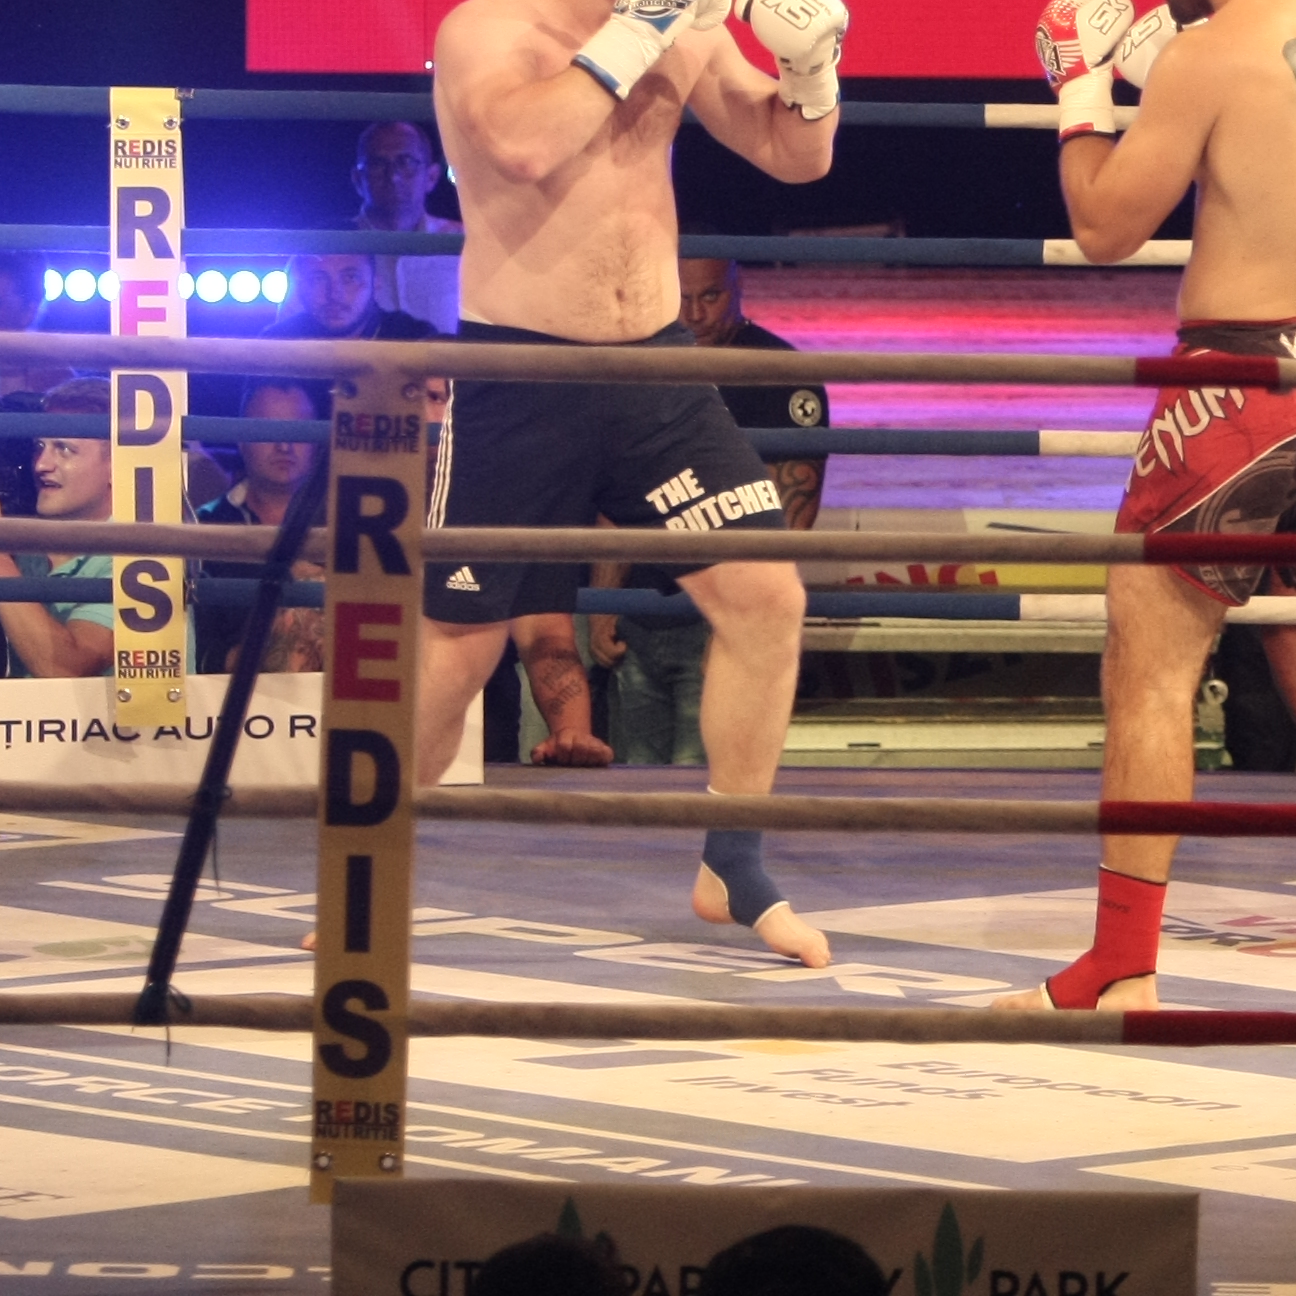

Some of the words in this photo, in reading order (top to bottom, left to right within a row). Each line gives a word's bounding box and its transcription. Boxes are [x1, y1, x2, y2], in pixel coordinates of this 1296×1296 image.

[113, 139, 178, 157] REDIS
[114, 157, 178, 169] NUTRITIE
[115, 186, 175, 634] REDIS
[335, 412, 421, 436] REDIS
[335, 436, 421, 454] NUTRITIE
[1125, 387, 1245, 493] ENUM
[645, 468, 705, 515] THE
[446, 581, 481, 592] adidas
[117, 650, 181, 666] REDIS
[117, 667, 181, 679] NUTRITIE
[153, 715, 274, 740] AUO
[318, 477, 411, 1080] REDIS
[668, 1076, 911, 1108] Invest
[772, 1069, 1002, 1100] Funds
[876, 1060, 1241, 1111] European
[316, 1101, 400, 1124] REDIS
[314, 1124, 399, 1142] NUTRITIE
[399, 1259, 490, 1296] CIT
